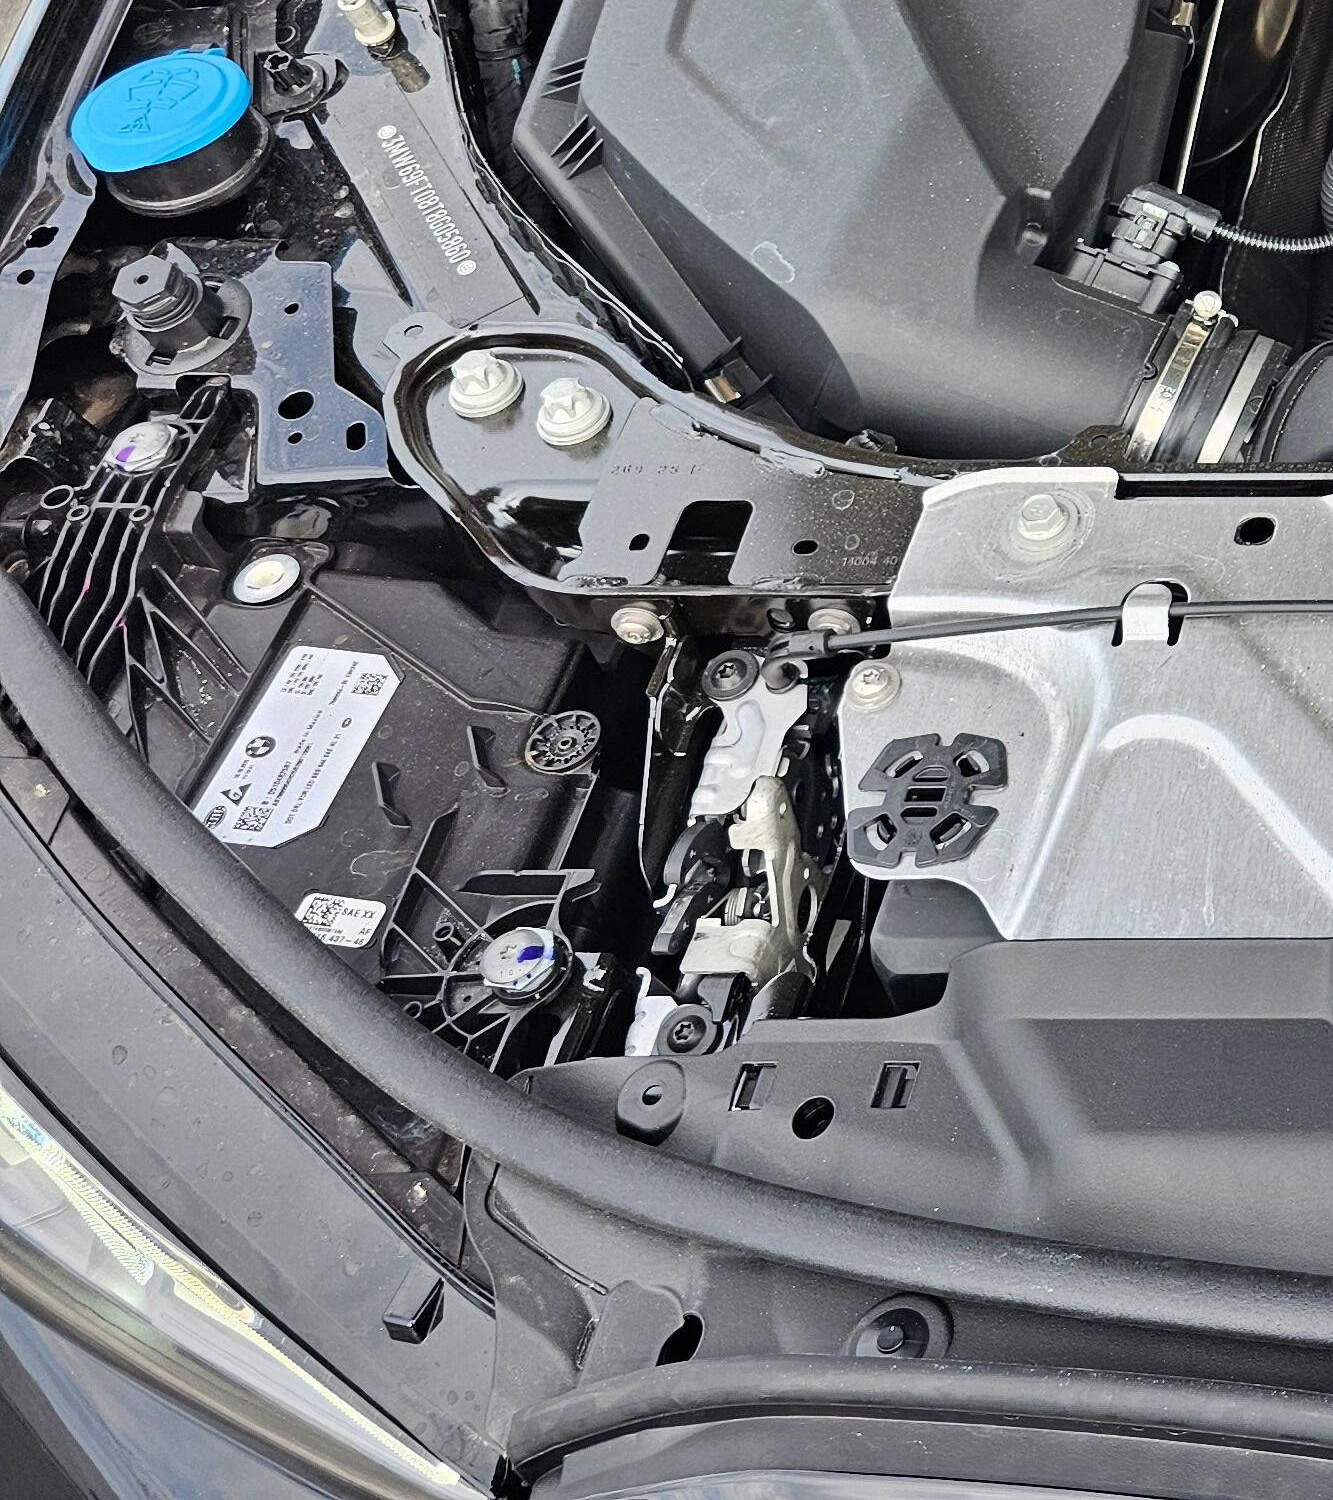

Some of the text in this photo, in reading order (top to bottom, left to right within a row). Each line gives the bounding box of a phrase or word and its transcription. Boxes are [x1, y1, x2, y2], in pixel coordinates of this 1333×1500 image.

[379, 133, 472, 265] 3MW69FT08T8G05860
[340, 907, 377, 919] SAE XX
[357, 927, 372, 935] AF
